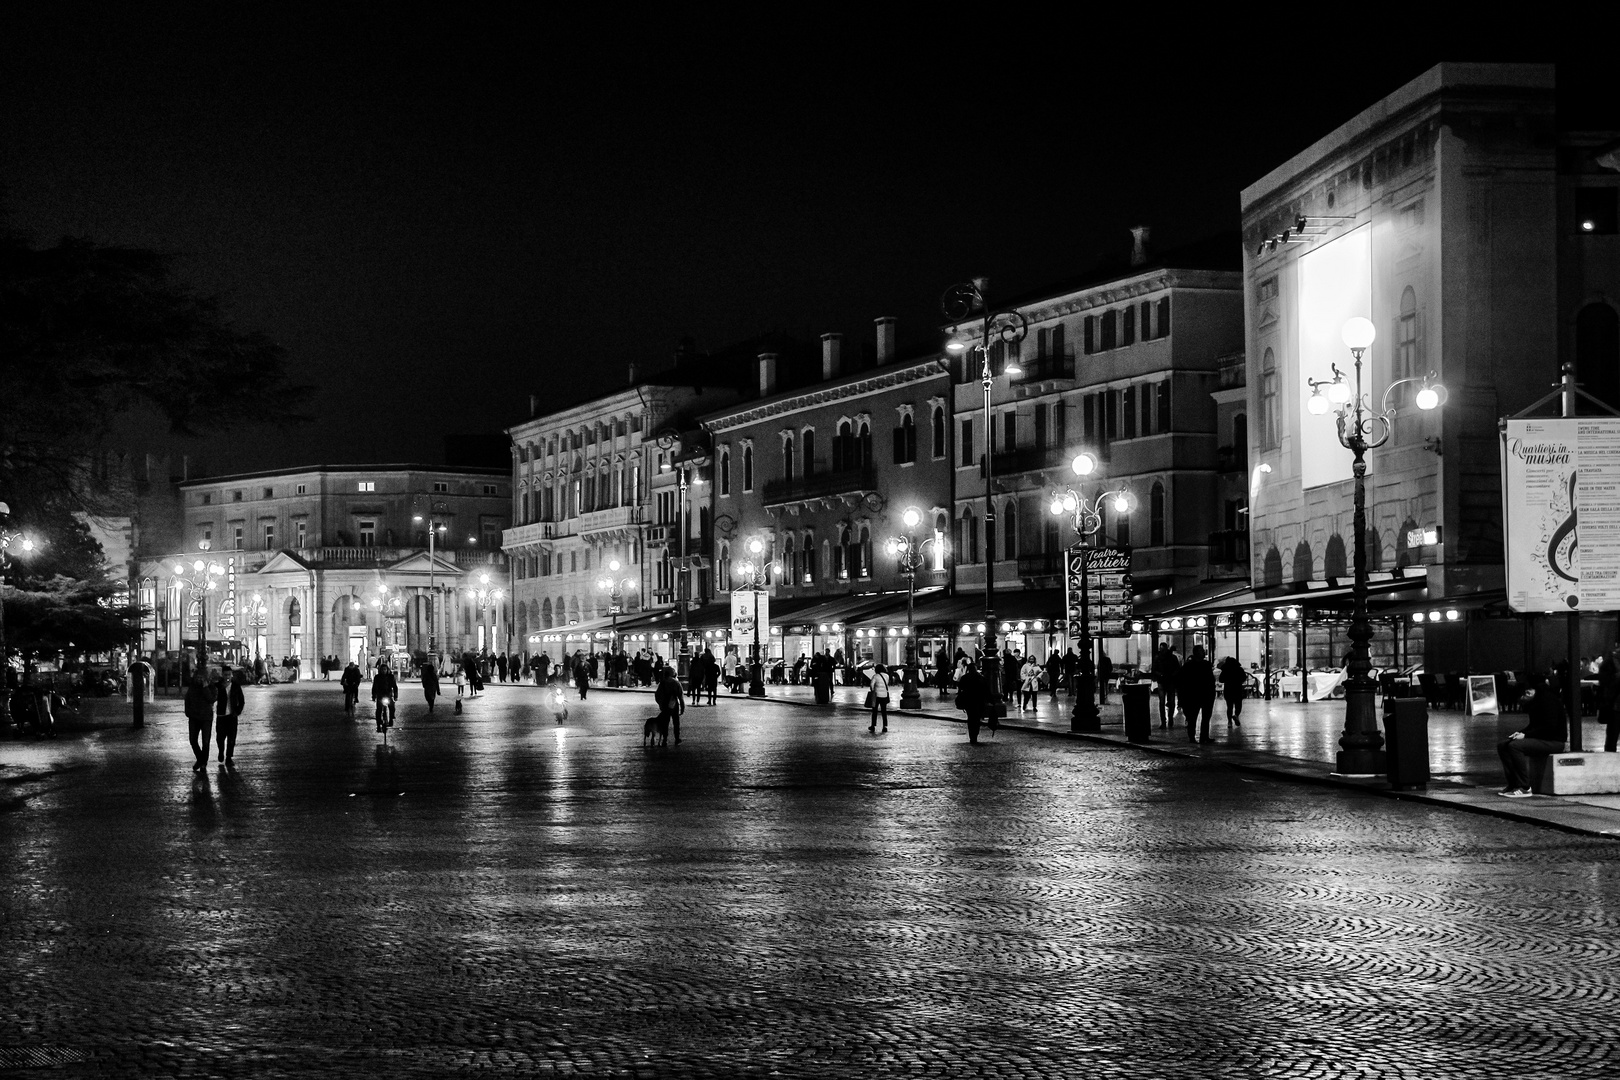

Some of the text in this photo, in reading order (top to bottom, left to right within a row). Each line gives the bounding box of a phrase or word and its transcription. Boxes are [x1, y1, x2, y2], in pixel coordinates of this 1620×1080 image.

[1507, 437, 1556, 460] Quartieri
[1525, 451, 1571, 466] musica
[1088, 549, 1118, 560] Teatro
[1070, 556, 1130, 574] Qartieri
